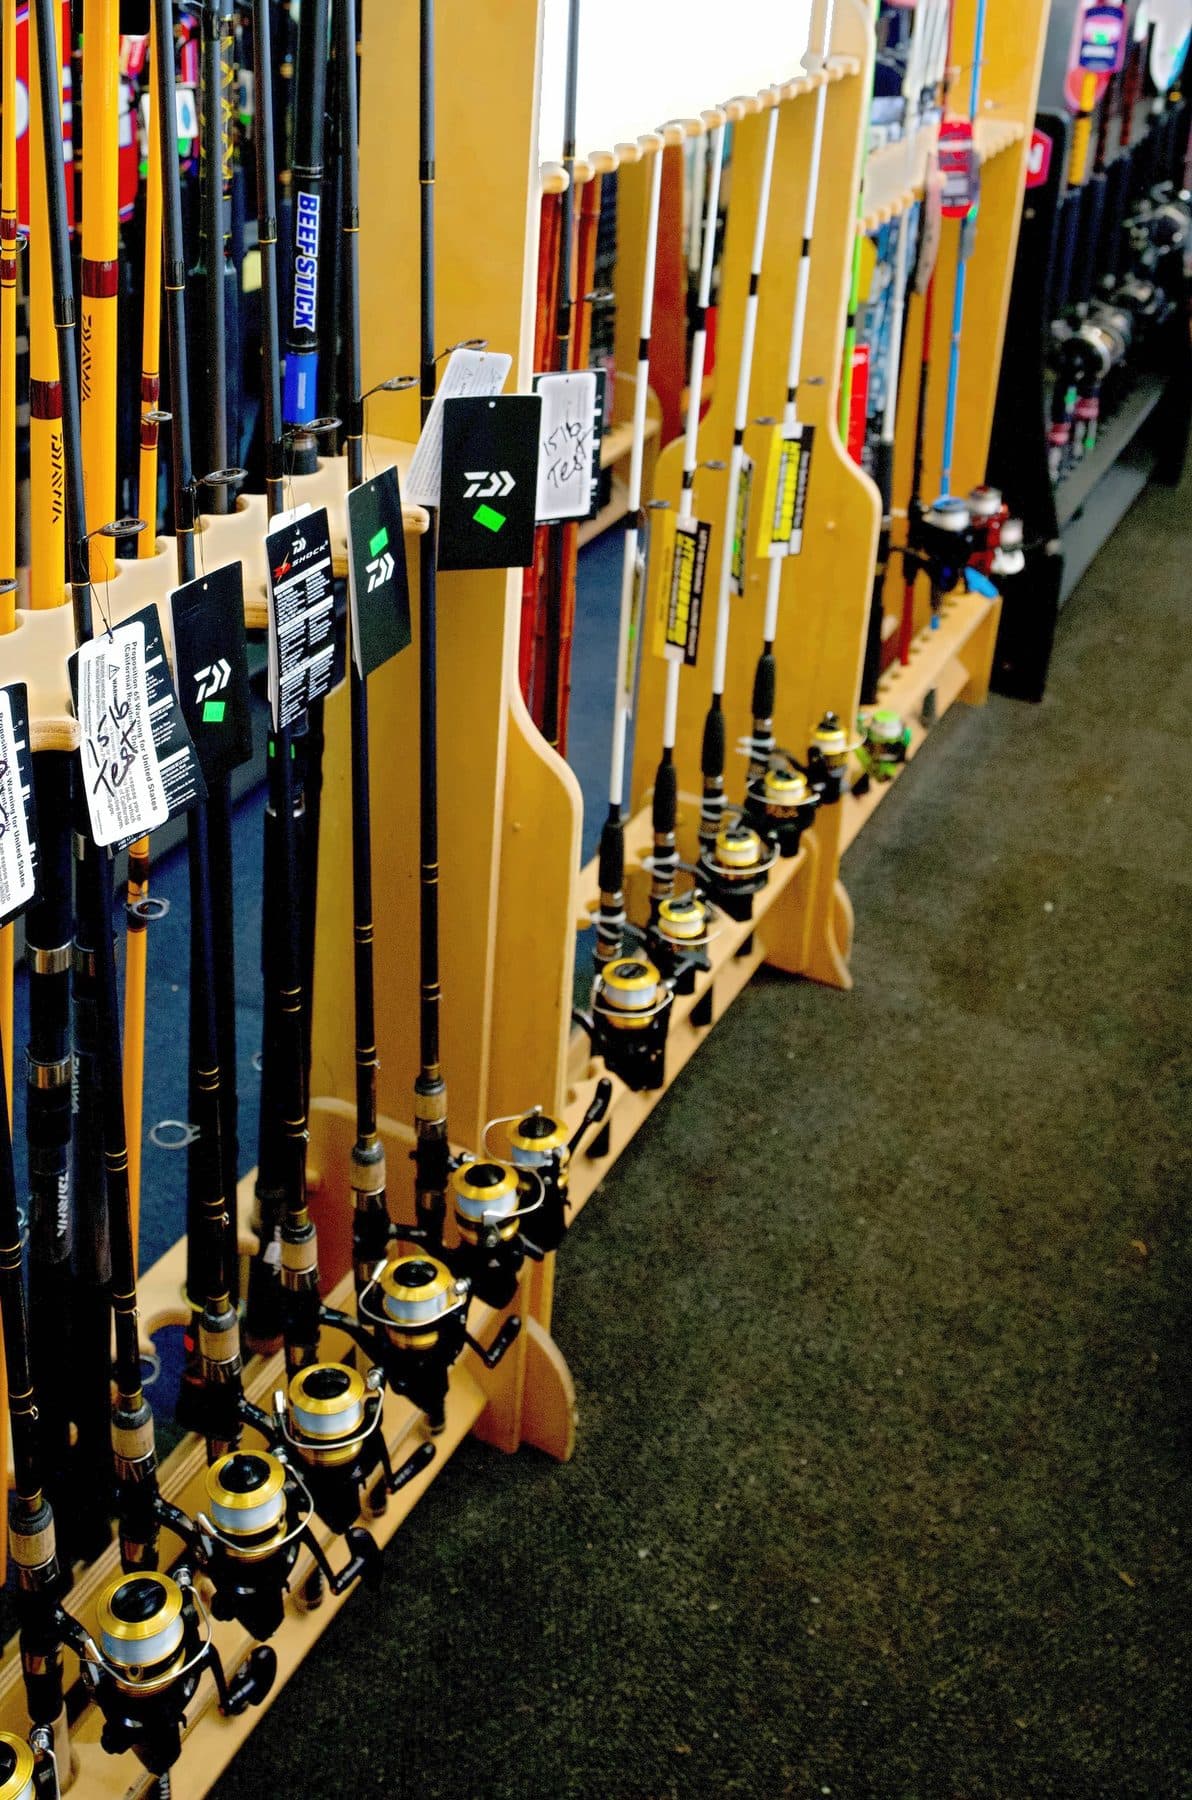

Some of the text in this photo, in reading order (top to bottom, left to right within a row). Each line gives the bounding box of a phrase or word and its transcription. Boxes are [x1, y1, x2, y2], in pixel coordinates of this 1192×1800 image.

[51, 432, 63, 524] DAIWA
[134, 691, 140, 702] 65
[135, 703, 144, 739] Warning
[142, 755, 153, 783] United
[148, 783, 158, 812] States
[7, 777, 15, 814] Warning
[14, 830, 23, 859] United
